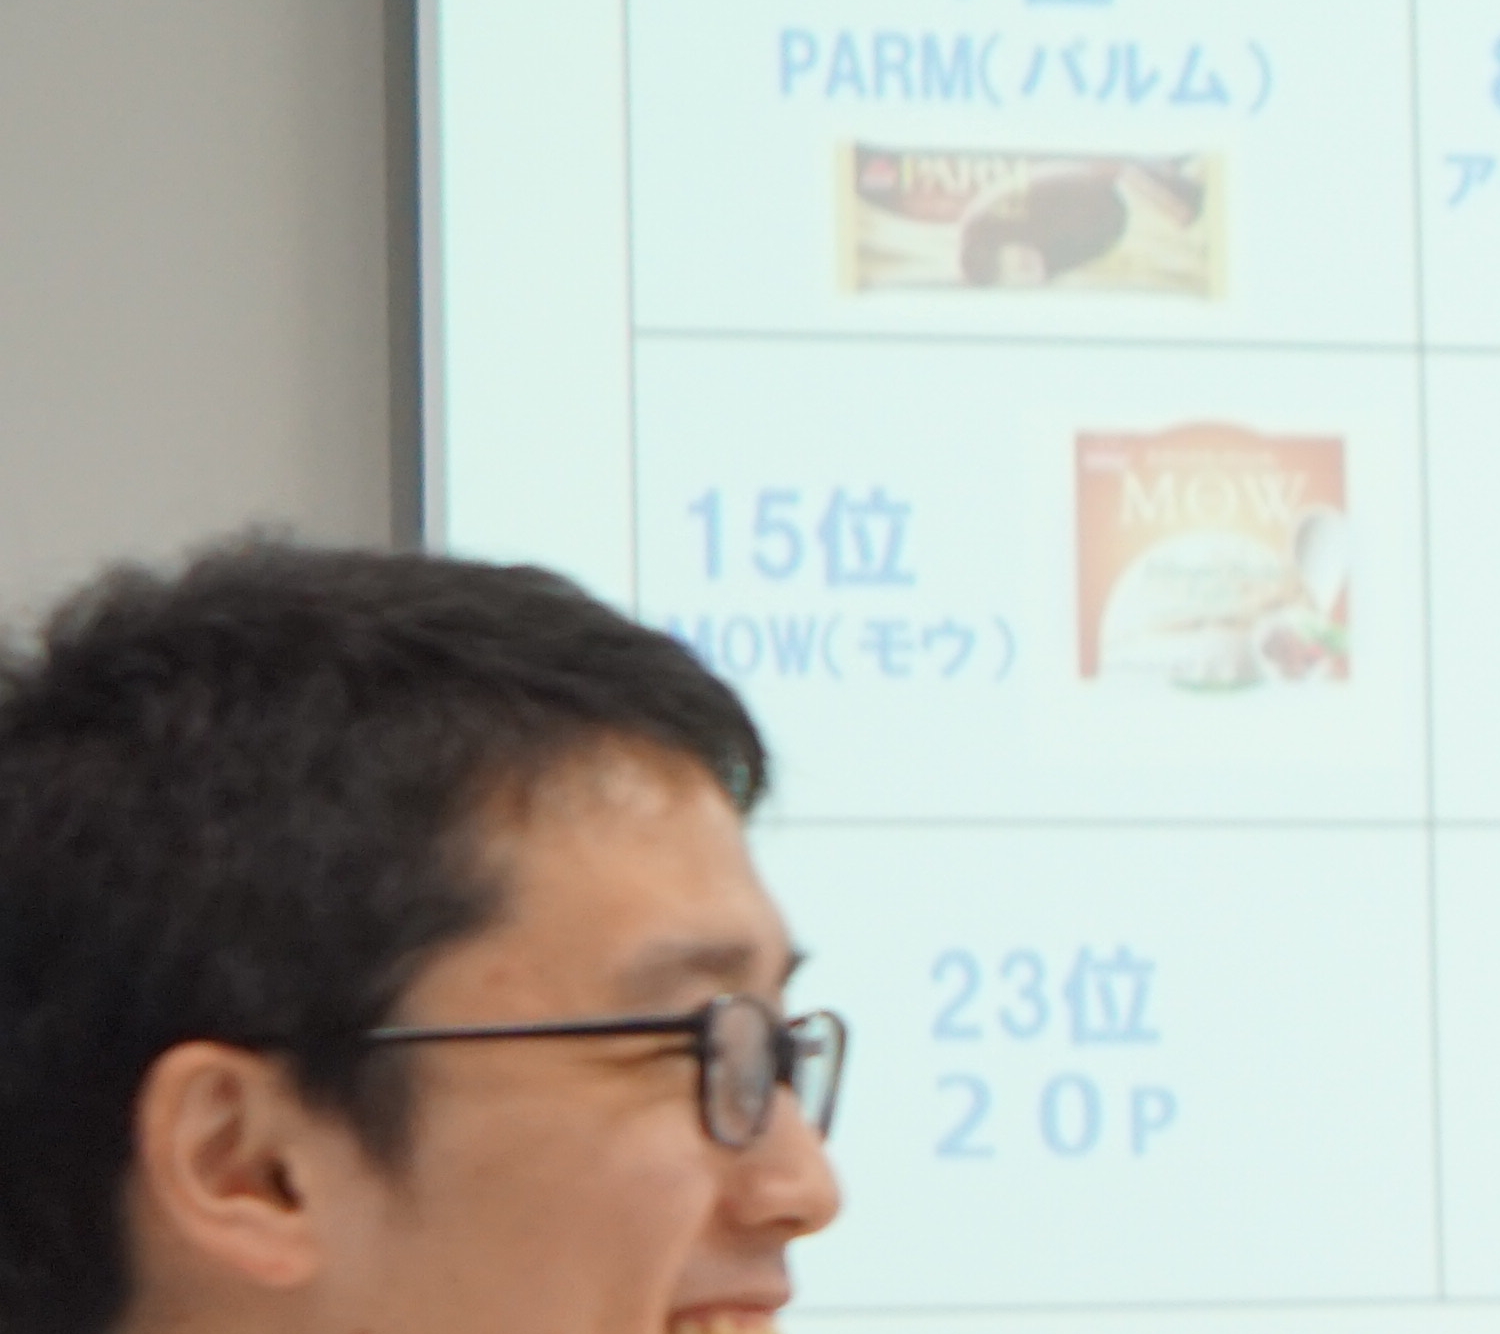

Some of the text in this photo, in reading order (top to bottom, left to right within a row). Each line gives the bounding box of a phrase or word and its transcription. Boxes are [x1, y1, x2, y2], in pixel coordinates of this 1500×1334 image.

[686, 486, 918, 589] 15位
[1118, 473, 1308, 527] MOW
[930, 943, 1161, 1047] 23位
